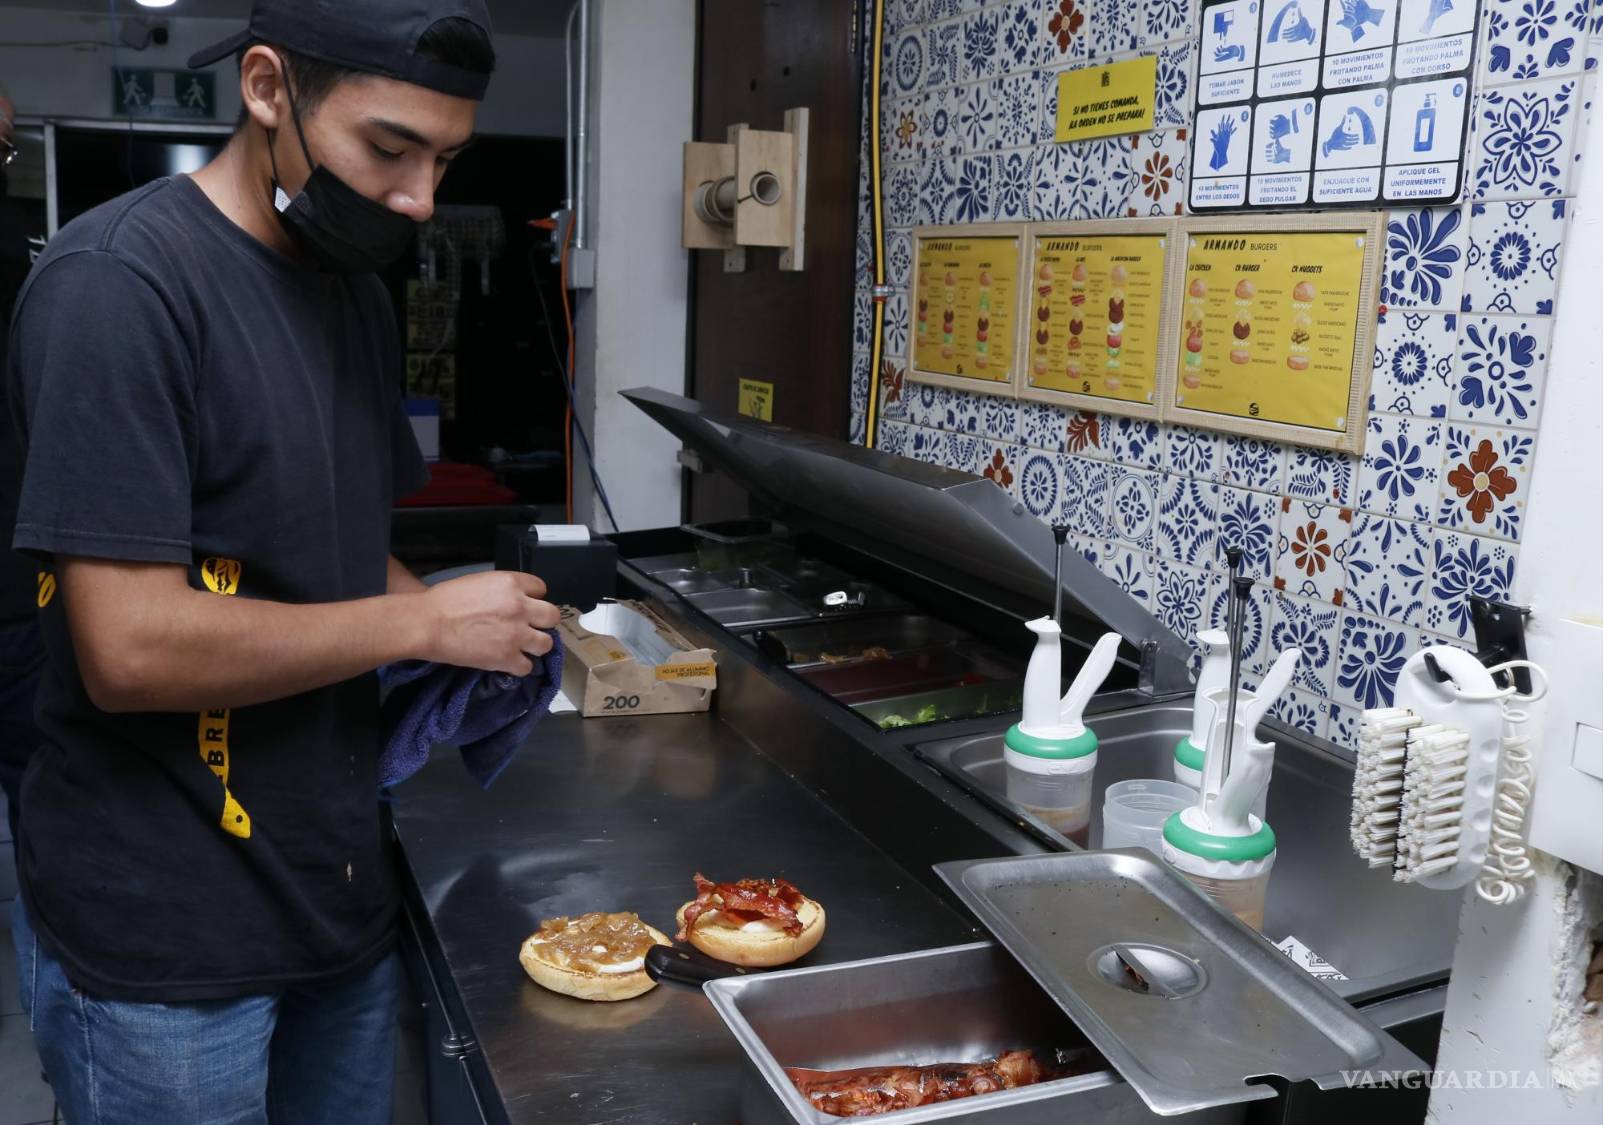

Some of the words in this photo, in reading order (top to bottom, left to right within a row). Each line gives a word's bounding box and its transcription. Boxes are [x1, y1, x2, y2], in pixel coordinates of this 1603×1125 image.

[1340, 52, 1384, 65] MOVIMIENTOS
[1440, 50, 1464, 60] PALMA
[1329, 66, 1362, 76] FROTANDO
[1363, 62, 1385, 71] PALMA
[1427, 63, 1451, 73] DORSO
[1338, 77, 1351, 85] CON
[1352, 74, 1373, 83] PALMA
[1211, 88, 1240, 97] SUFICIENTE
[1073, 106, 1080, 115] SI
[1080, 104, 1089, 113] NO
[1090, 100, 1109, 112] TIENES
[1078, 116, 1097, 128] ORDEN
[1097, 115, 1106, 125] NO
[1107, 113, 1115, 123] SE
[1399, 168, 1426, 176] APLIQUE
[1264, 176, 1302, 184] MOVIMIENTOS
[1356, 176, 1370, 184] CON
[1319, 187, 1353, 195] SUFICIENTE
[1354, 186, 1372, 194] AGUA
[1418, 188, 1442, 196] MANOS
[1046, 241, 1079, 251] ARMANDO
[1203, 239, 1246, 251] ARMANDO
[1250, 243, 1277, 251] BURGERS
[1299, 265, 1323, 273] NUGGETS
[603, 695, 640, 710] 200
